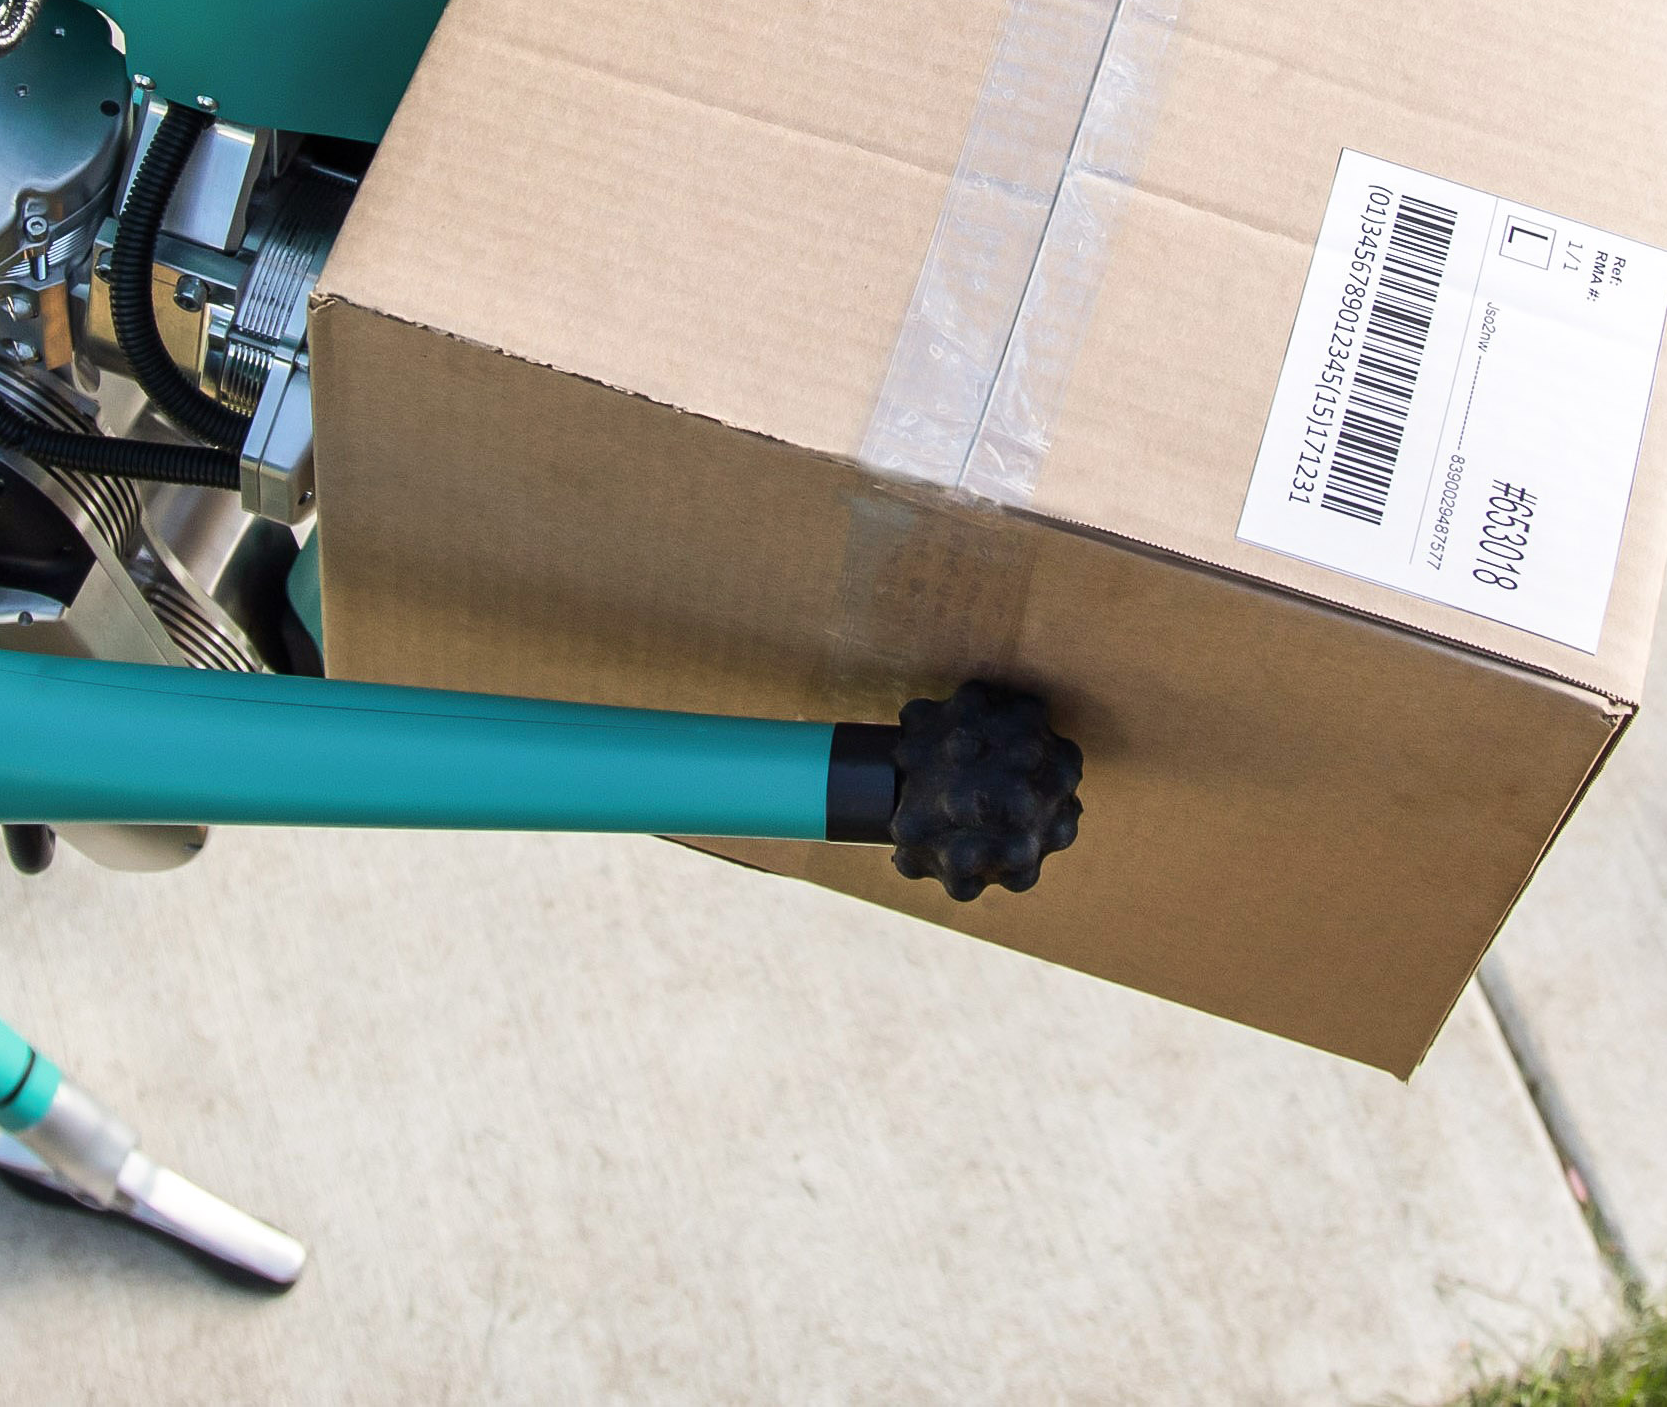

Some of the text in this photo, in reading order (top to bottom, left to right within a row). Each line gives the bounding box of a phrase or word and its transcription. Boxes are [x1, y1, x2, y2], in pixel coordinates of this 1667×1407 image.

[1507, 225, 1549, 244] L
[1562, 239, 1584, 271] 1/1
[1591, 249, 1609, 285] RMA
[1611, 255, 1627, 287] Ref:
[1288, 184, 1394, 504] (01)3456789012345(15)171231
[1426, 301, 1500, 571] Jso2nw 8390029487577
[1472, 479, 1538, 590] #653018
